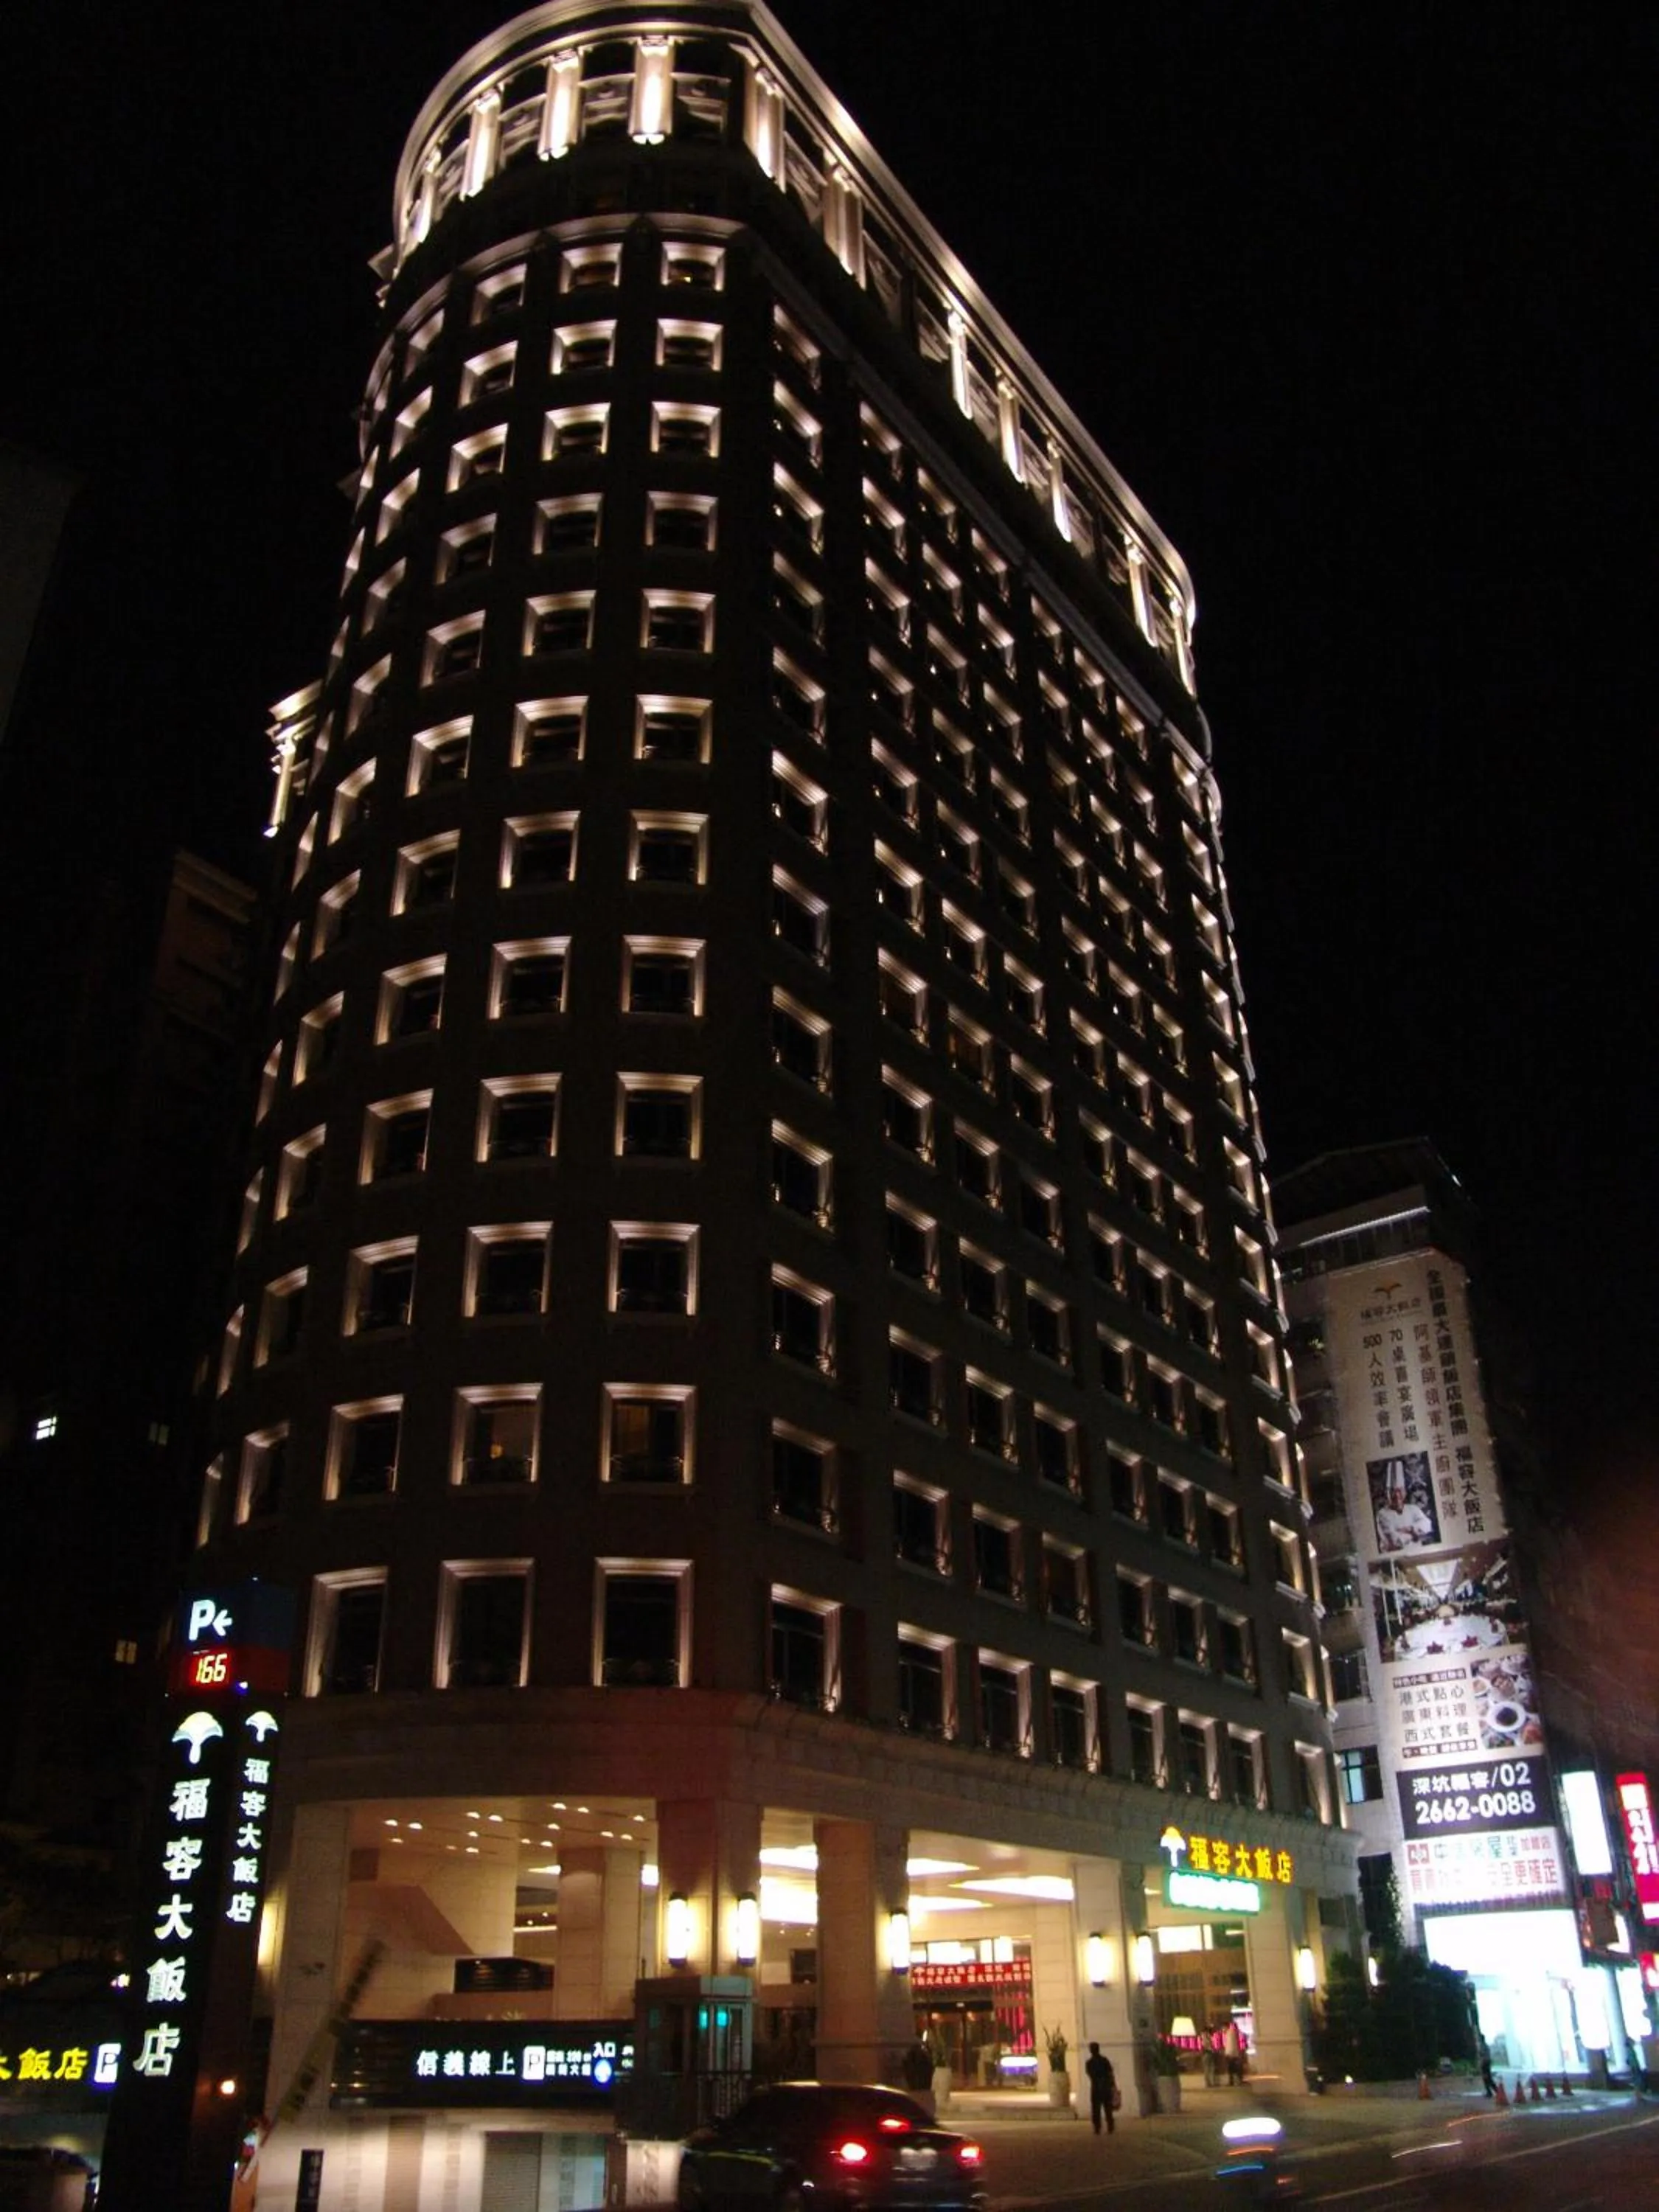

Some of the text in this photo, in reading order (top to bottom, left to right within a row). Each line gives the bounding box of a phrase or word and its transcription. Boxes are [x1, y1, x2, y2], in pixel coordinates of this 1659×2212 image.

[1455, 1446, 1484, 1534] 福容大飯店
[189, 1599, 216, 1641] P
[194, 1653, 228, 1684] 166
[1415, 1791, 1536, 1825] 2662-0088
[226, 1758, 270, 1923] 福容大飯店
[1189, 1837, 1291, 1882] 福容大飯店
[132, 1778, 211, 2077] 福容大飯店
[417, 2050, 515, 2076] 信義線上
[593, 2042, 616, 2059] 入口
